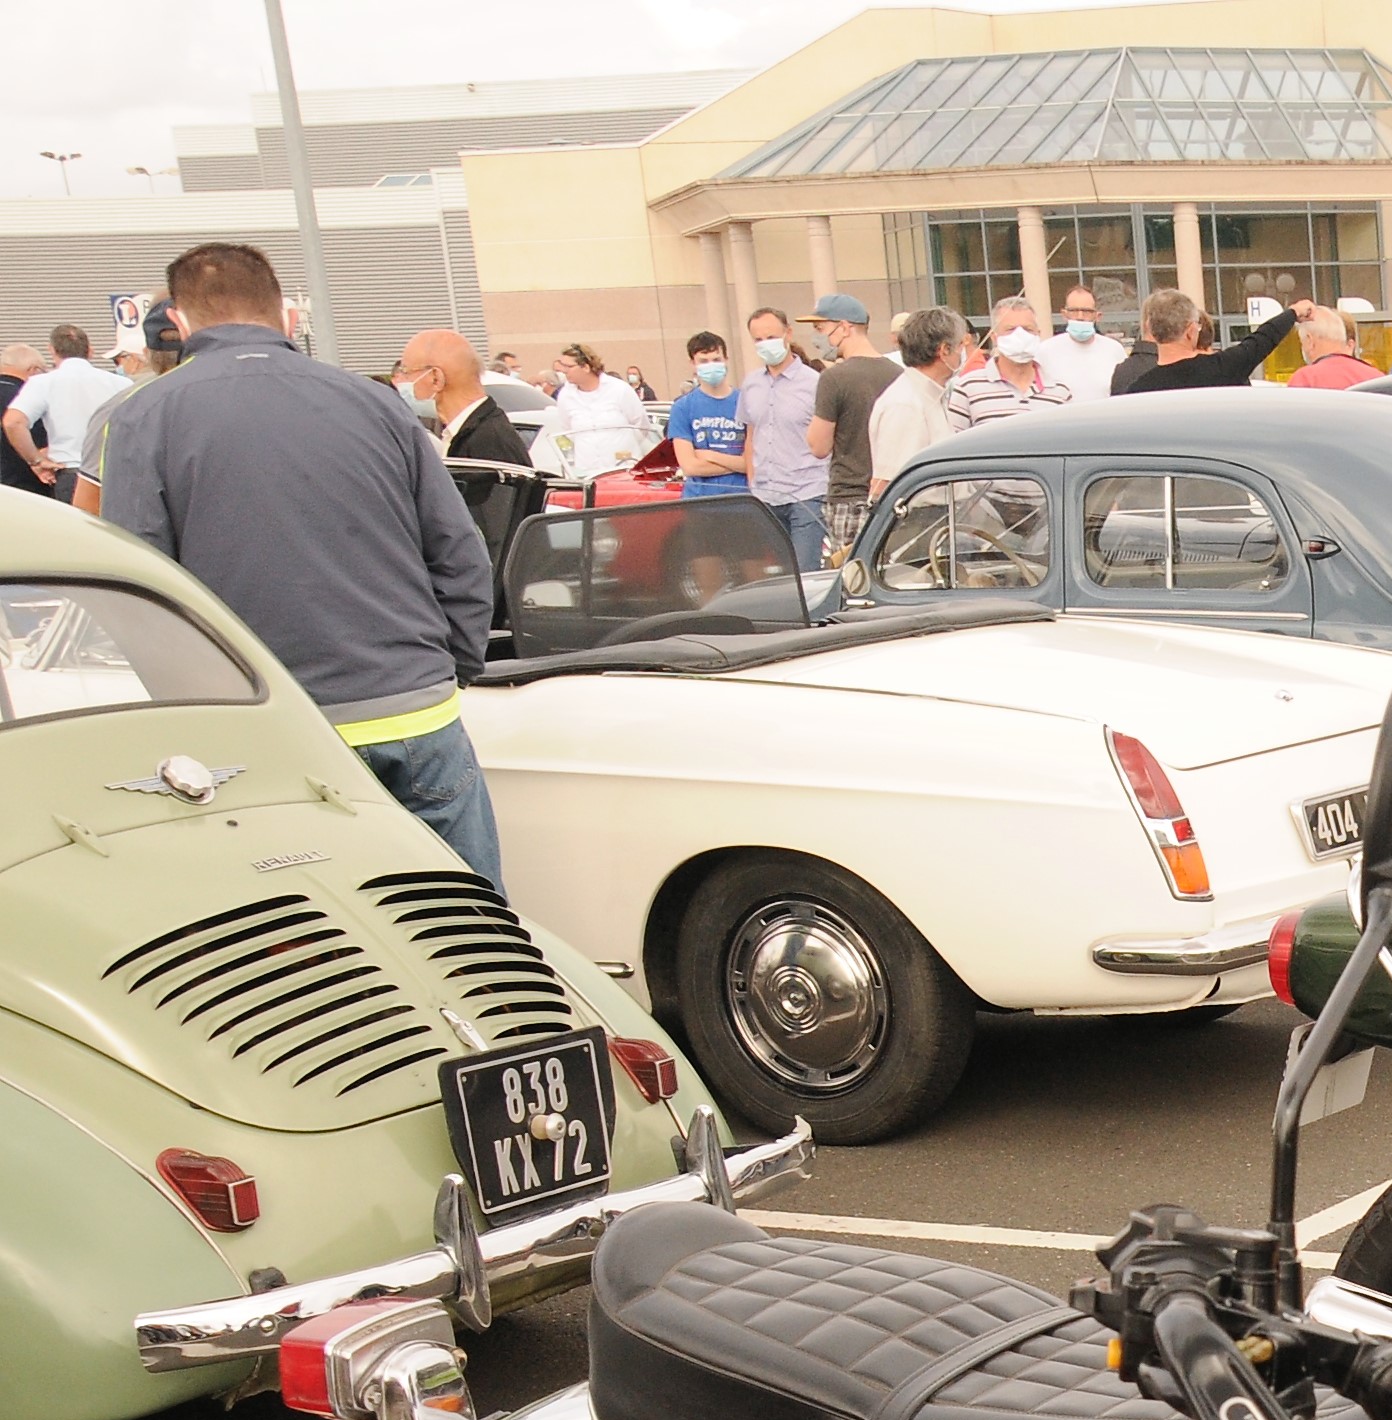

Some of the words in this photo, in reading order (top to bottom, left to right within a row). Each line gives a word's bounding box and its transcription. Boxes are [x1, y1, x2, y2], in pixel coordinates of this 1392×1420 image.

[1250, 300, 1261, 317] H
[1317, 799, 1359, 846] 404
[502, 1057, 568, 1124] 838
[493, 1132, 542, 1197] KX
